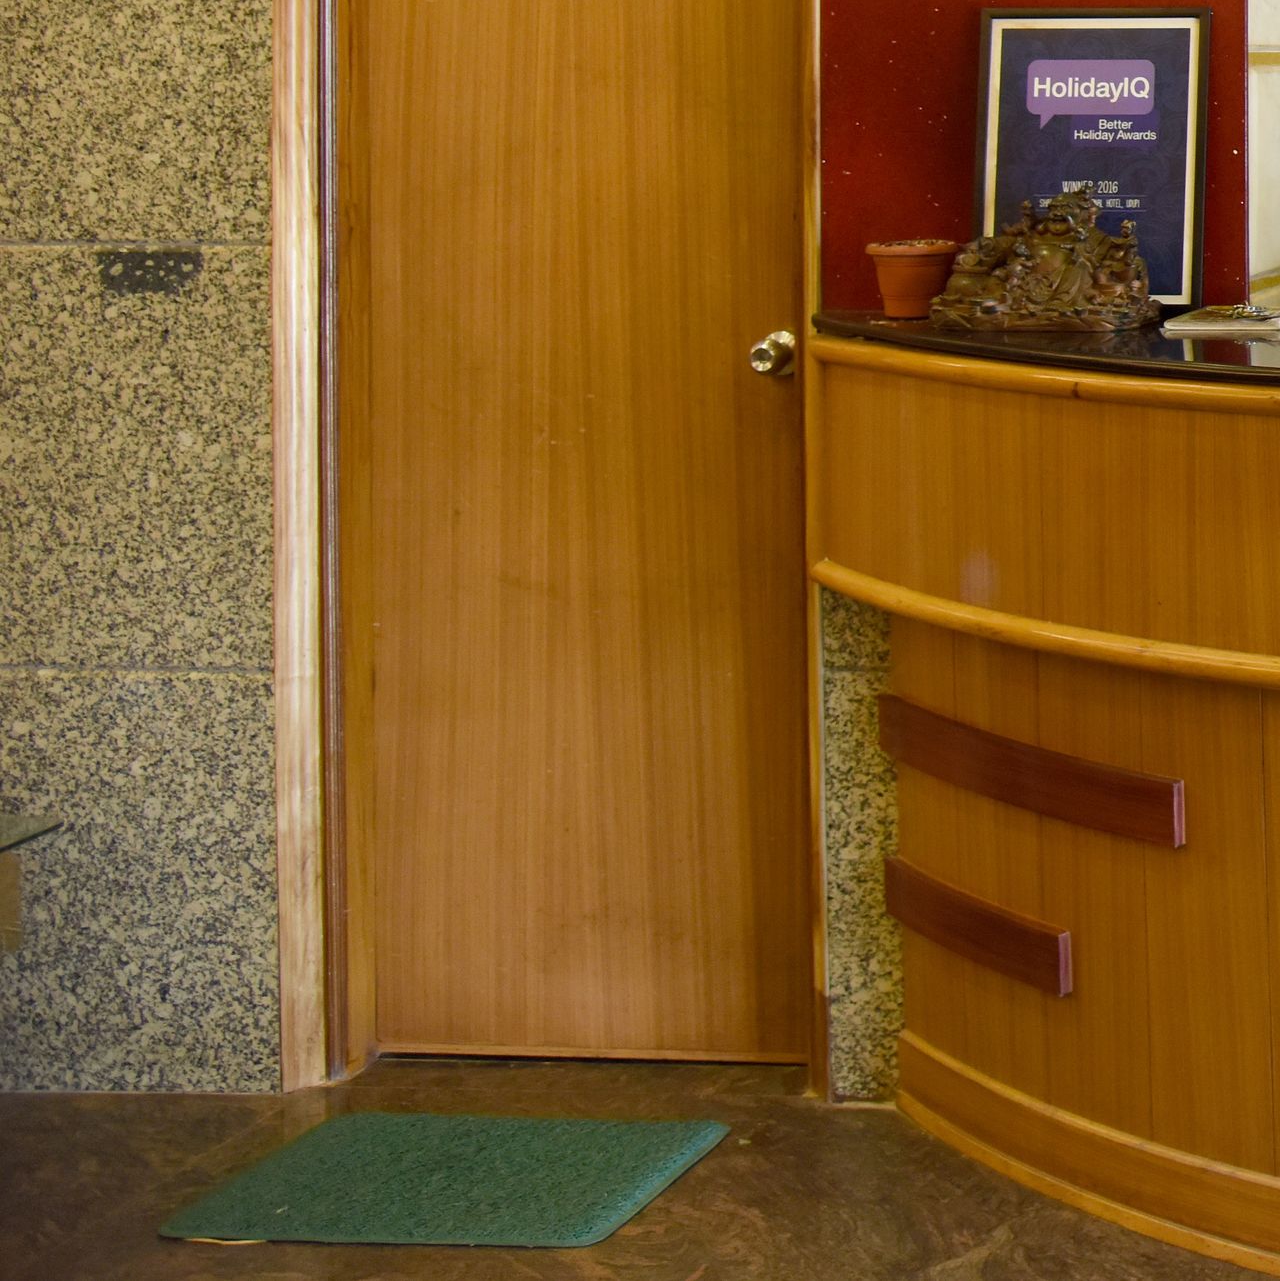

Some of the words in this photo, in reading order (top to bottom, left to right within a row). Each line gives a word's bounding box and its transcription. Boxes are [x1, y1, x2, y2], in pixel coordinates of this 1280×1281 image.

[1033, 77, 1150, 103] HolidayIQ
[1098, 119, 1133, 130] Better
[1074, 130, 1114, 142] Holiday
[1116, 130, 1157, 140] Awards
[1098, 181, 1118, 194] 2016
